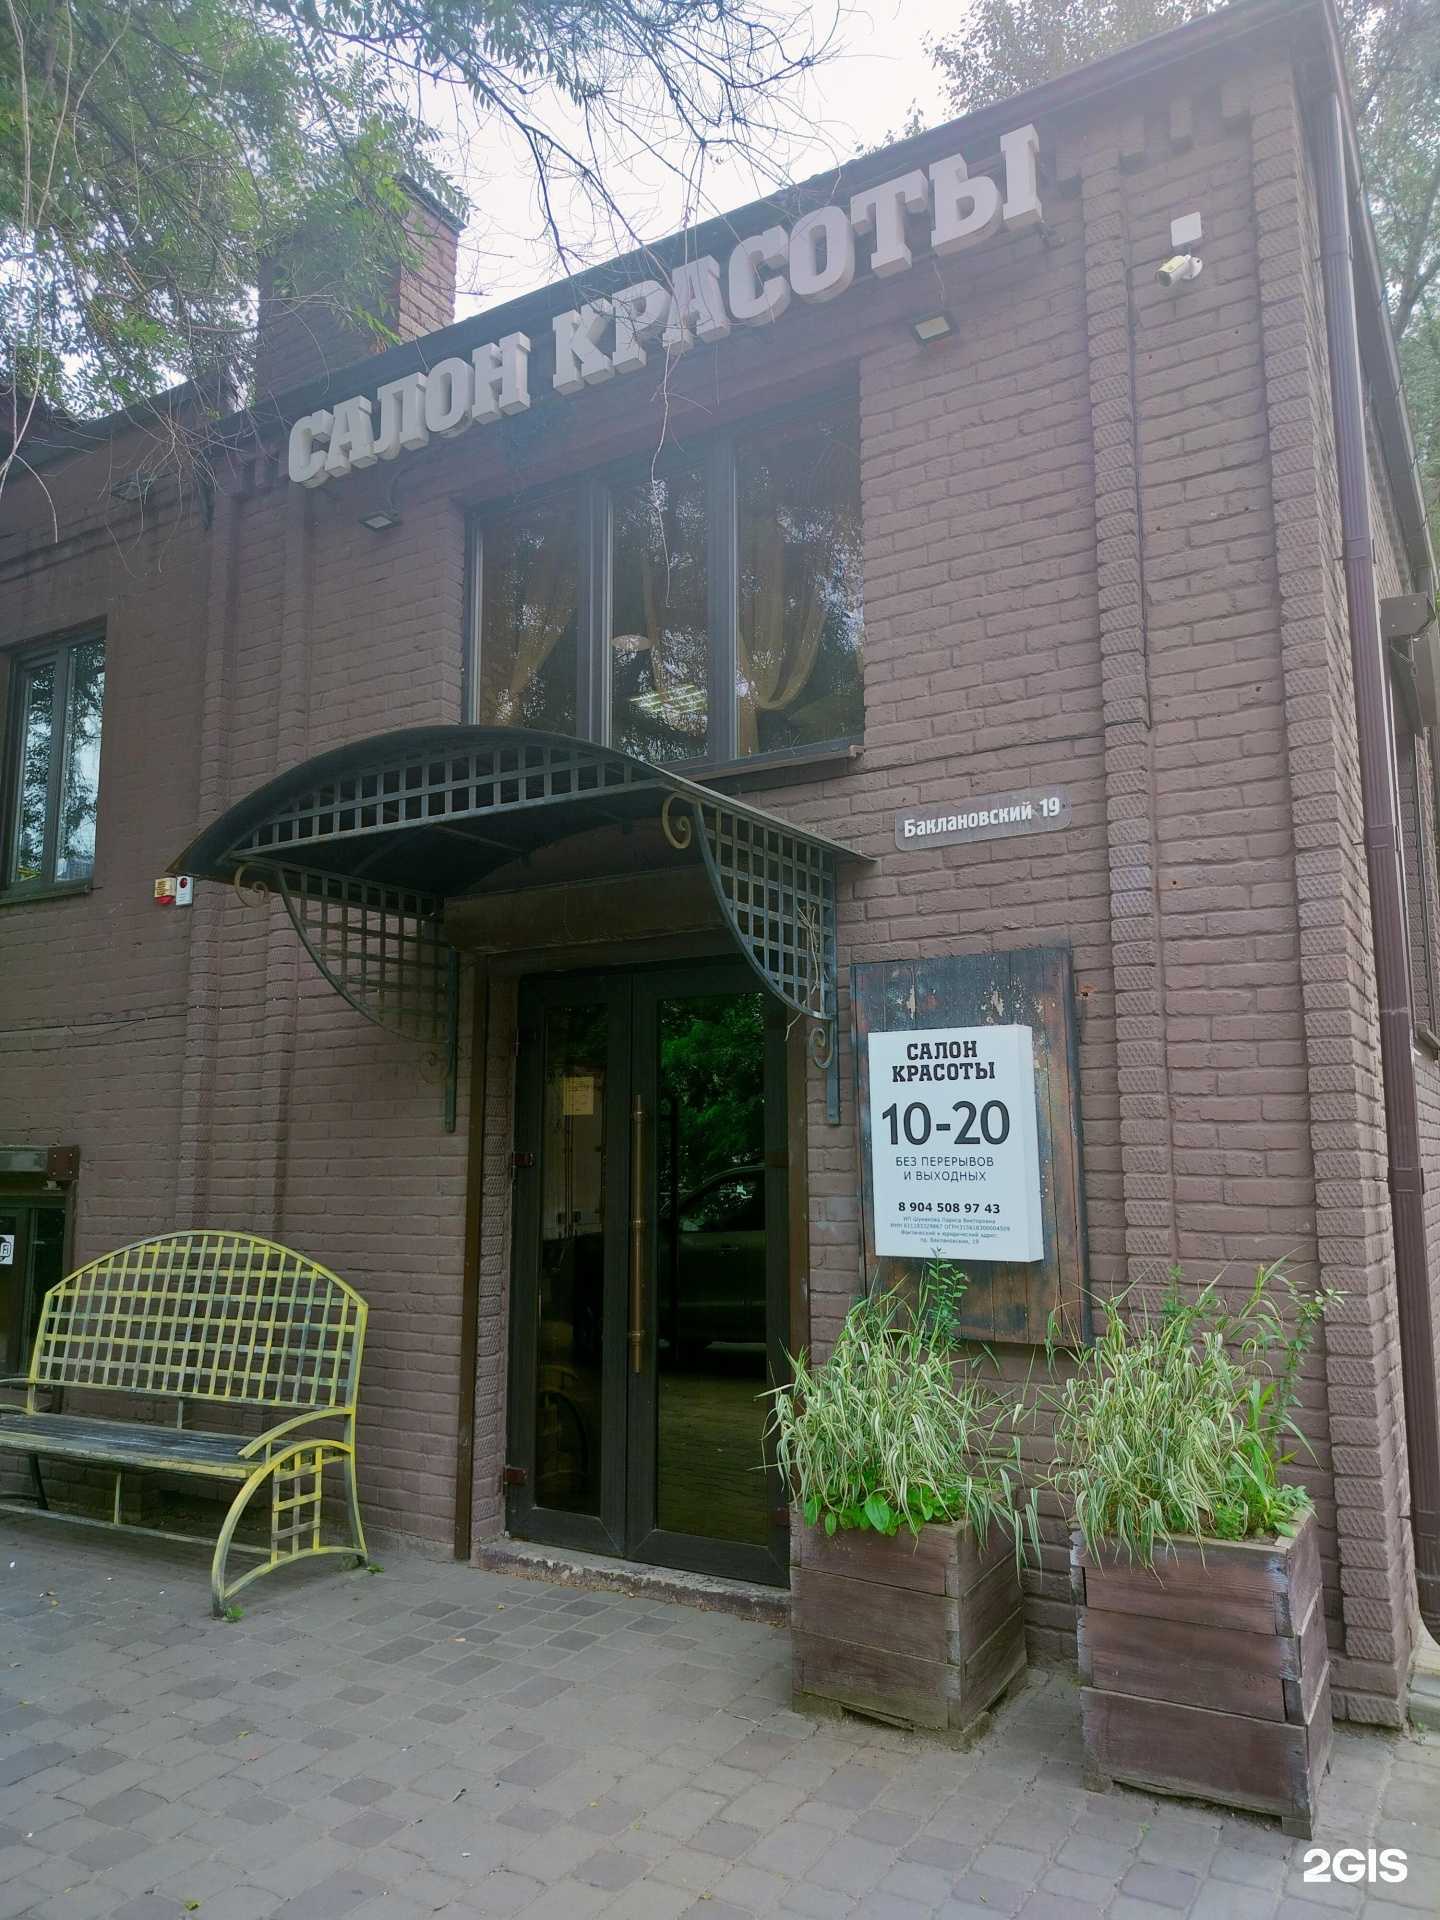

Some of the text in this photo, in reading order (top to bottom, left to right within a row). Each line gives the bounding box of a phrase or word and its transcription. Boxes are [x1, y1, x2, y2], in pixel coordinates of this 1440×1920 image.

[287, 123, 1044, 488] САЛОН КРАСОТЫ
[903, 796, 1060, 838] Баклановский 19
[906, 1040, 978, 1061] САЛОН
[892, 1061, 996, 1083] КРАСОТЫ
[882, 1099, 1011, 1146] 10-20
[895, 1156, 994, 1167] БЕЗ ПЕРЕРЫВОВ
[903, 1171, 987, 1182] И ВЫХОДНЫХ
[898, 1201, 1000, 1214] 8 904 508 97 43
